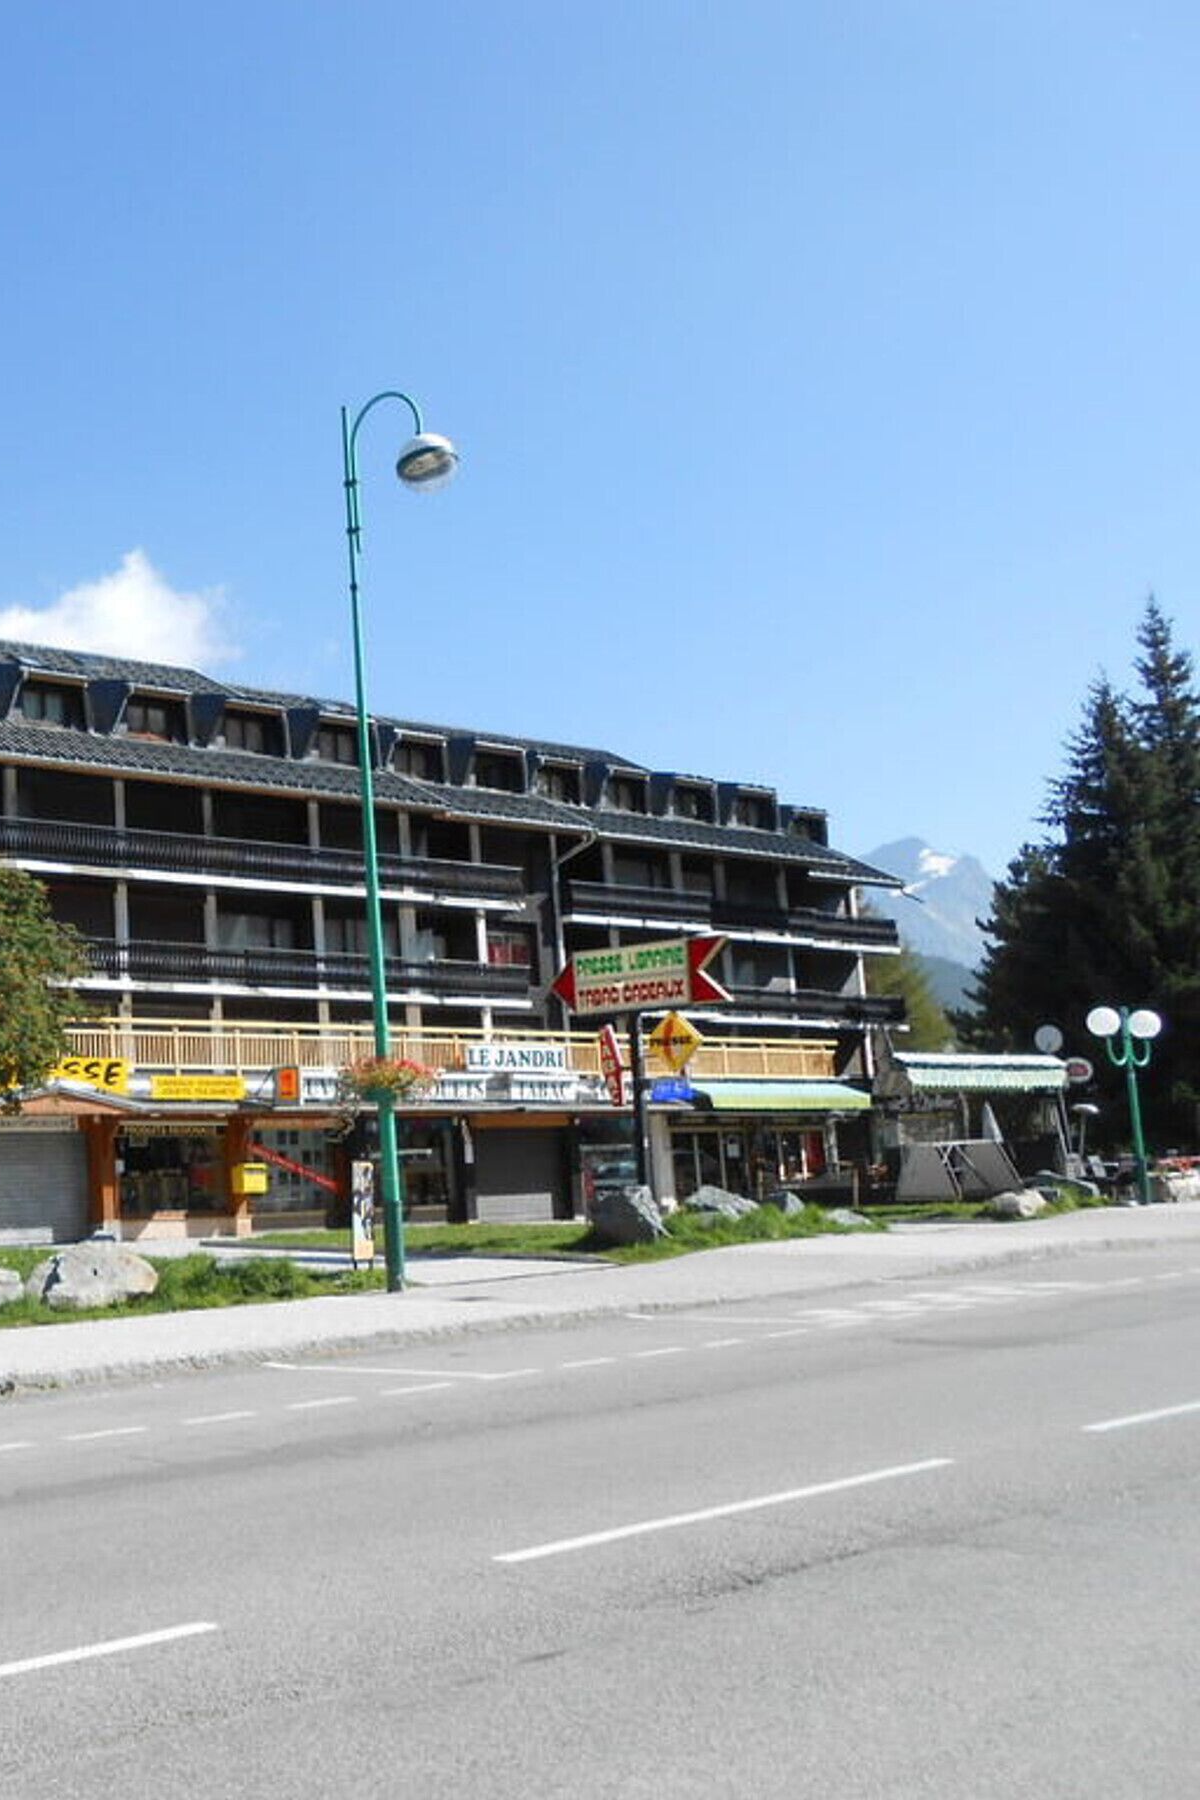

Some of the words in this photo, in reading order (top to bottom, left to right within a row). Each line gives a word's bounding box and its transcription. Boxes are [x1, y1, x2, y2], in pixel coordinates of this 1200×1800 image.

[624, 979, 684, 1003] CADEAUX
[468, 1049, 490, 1067] LE
[494, 1049, 564, 1068] JANDRI
